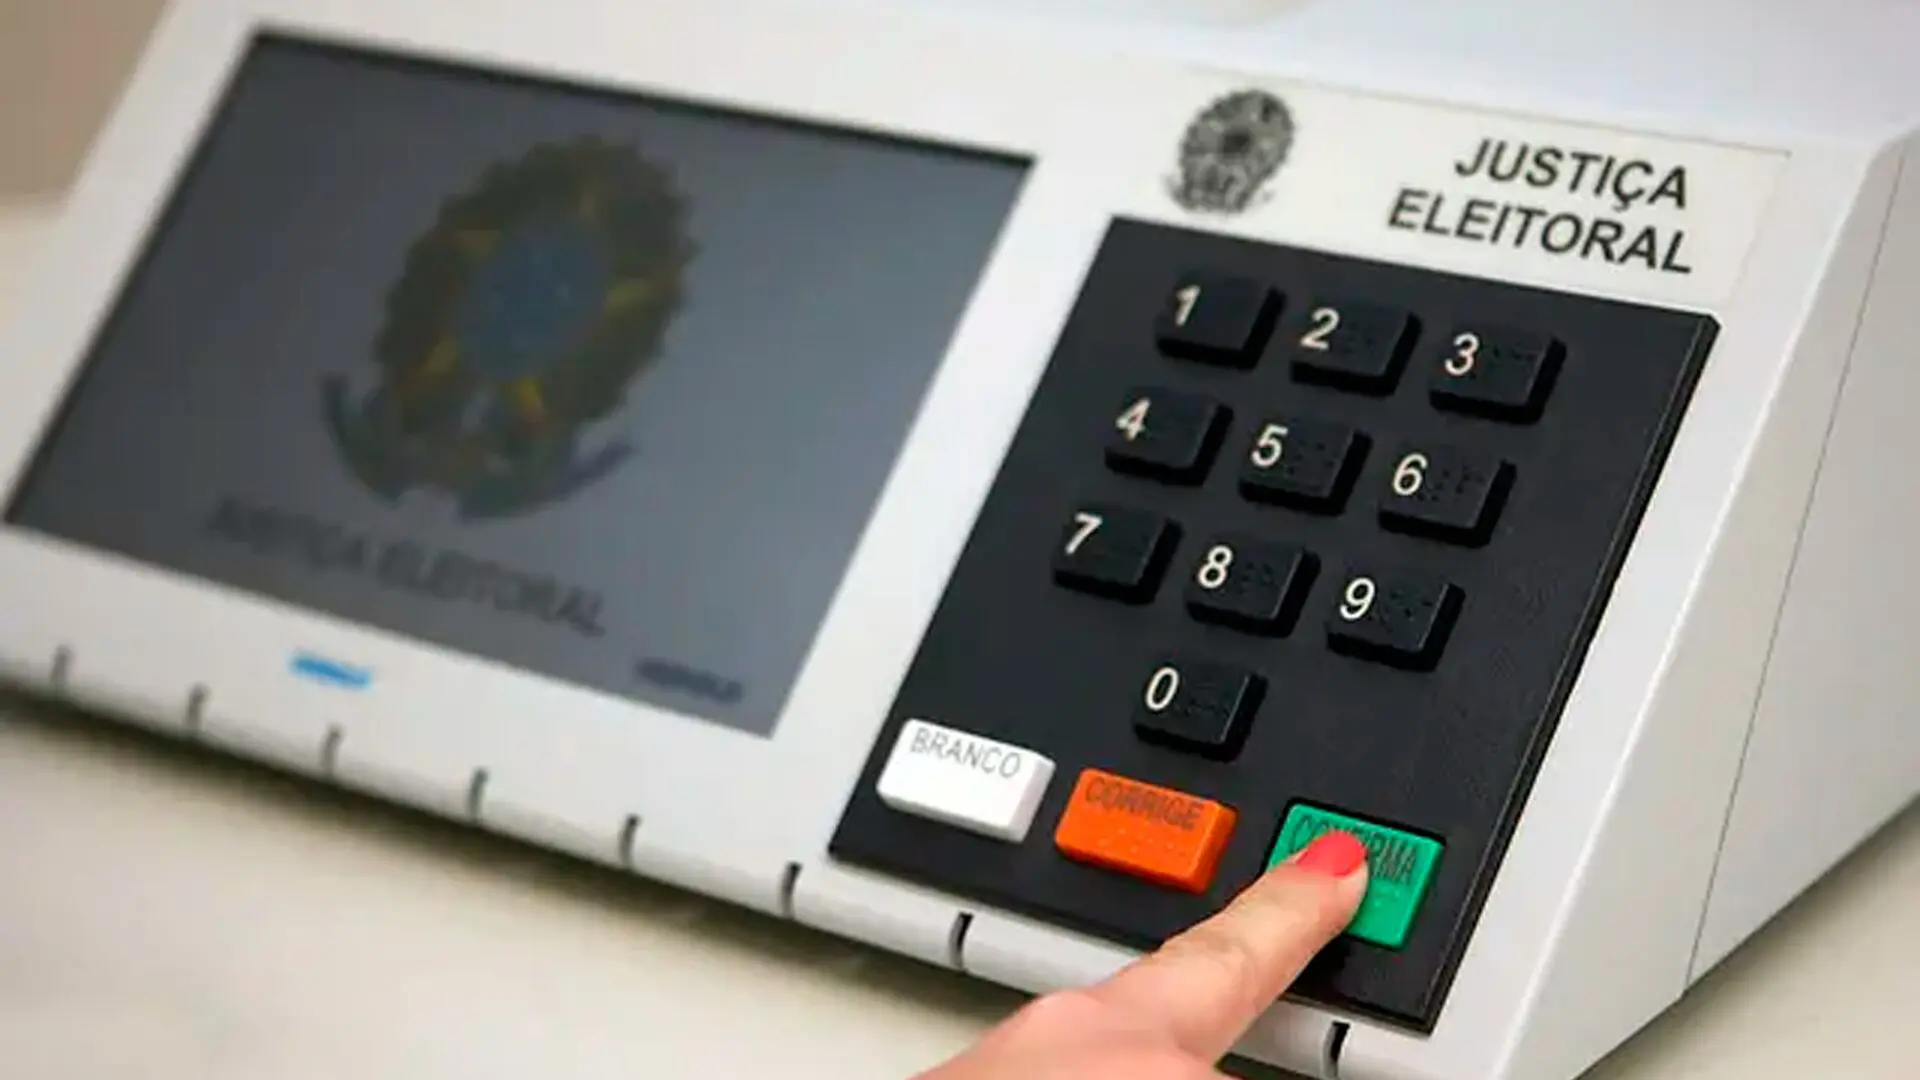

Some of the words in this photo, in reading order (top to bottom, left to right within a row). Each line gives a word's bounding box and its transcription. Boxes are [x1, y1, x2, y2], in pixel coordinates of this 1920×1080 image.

[1455, 138, 1687, 212] JUSTIÇA
[1387, 187, 1693, 275] ELEITORAL
[1175, 285, 1200, 326] 1
[1300, 307, 1340, 350] 2
[1444, 333, 1480, 376] 3
[1116, 399, 1151, 440] 4
[1251, 424, 1289, 467] 5
[1391, 453, 1428, 496] 6
[1066, 512, 1102, 554] 7
[1197, 545, 1234, 589] 8
[1339, 577, 1376, 620] 9
[1145, 667, 1180, 711] 0
[910, 727, 1022, 779] BRANCO
[1085, 775, 1205, 831] CORRIGE
[1288, 814, 1418, 886] CORMA
